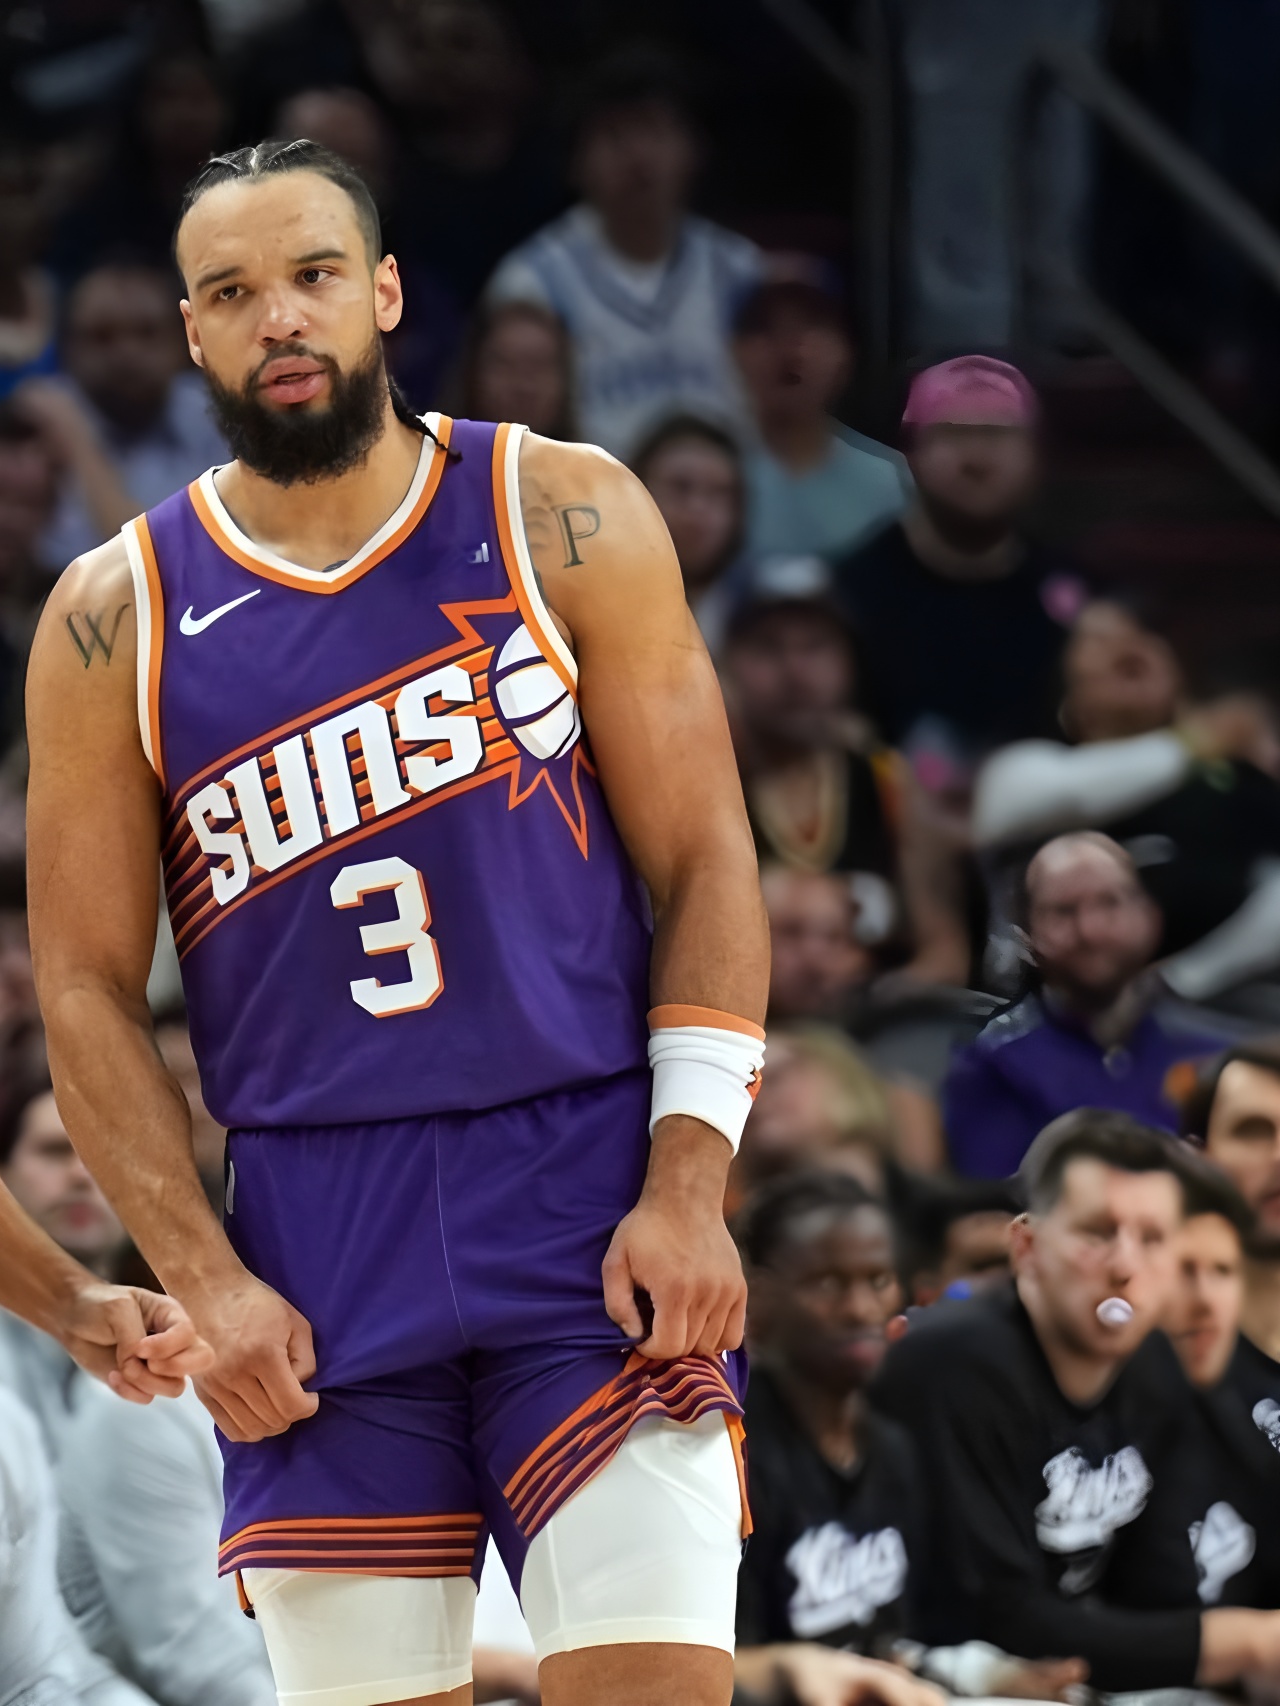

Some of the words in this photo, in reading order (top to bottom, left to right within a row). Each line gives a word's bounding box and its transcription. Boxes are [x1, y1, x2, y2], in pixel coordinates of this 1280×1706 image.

[551, 502, 601, 569] P
[65, 602, 131, 670] W
[186, 664, 485, 906] SUNS
[330, 855, 445, 1019] 3
